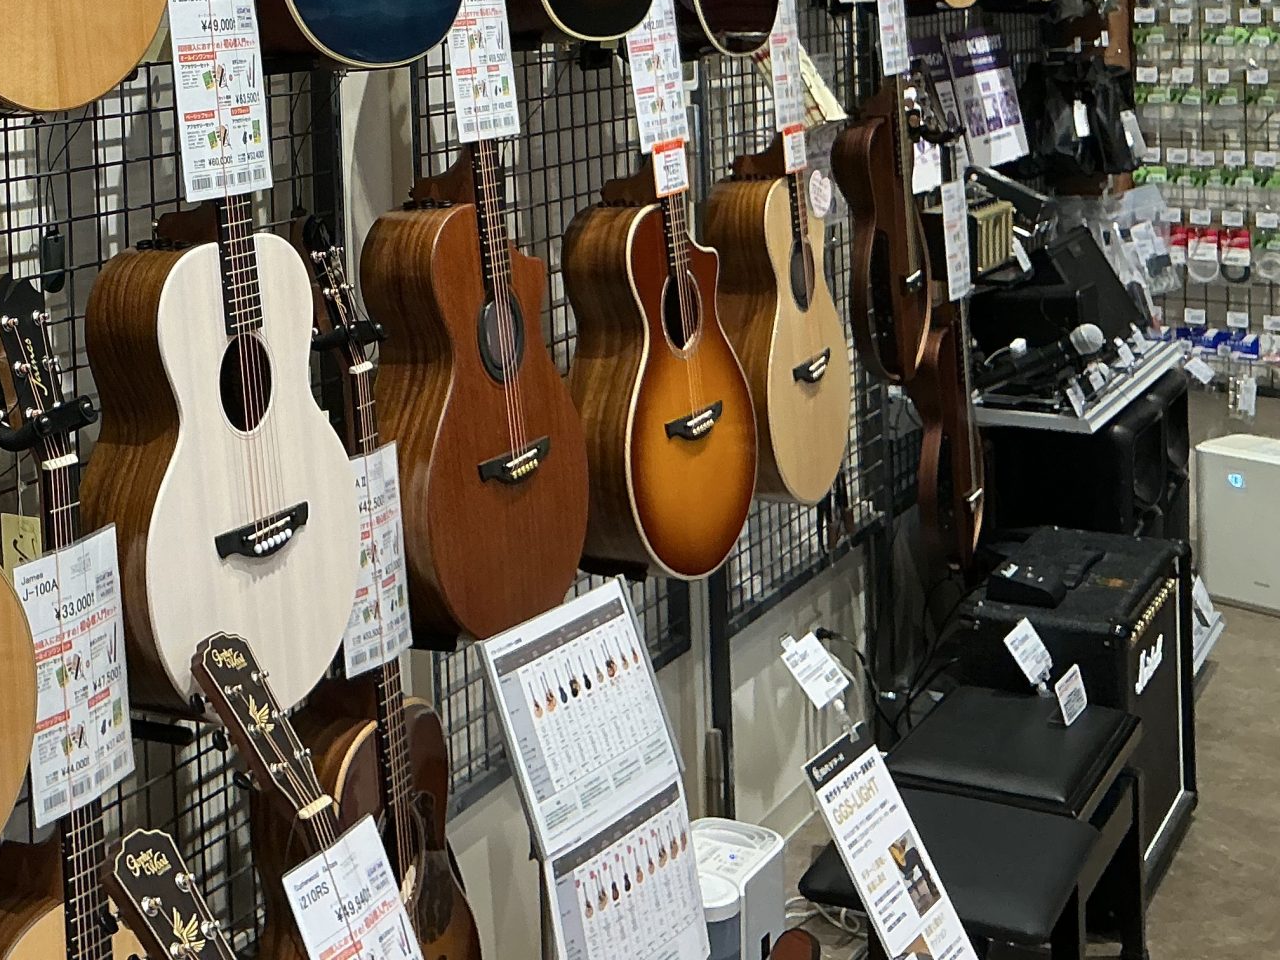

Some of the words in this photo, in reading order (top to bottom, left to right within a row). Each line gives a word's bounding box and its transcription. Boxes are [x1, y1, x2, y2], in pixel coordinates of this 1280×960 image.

[201, 19, 234, 32] ¥49,000
[24, 337, 48, 397] James
[21, 572, 44, 586] James
[23, 578, 59, 602] J-100A
[54, 592, 92, 620] ¥33,000
